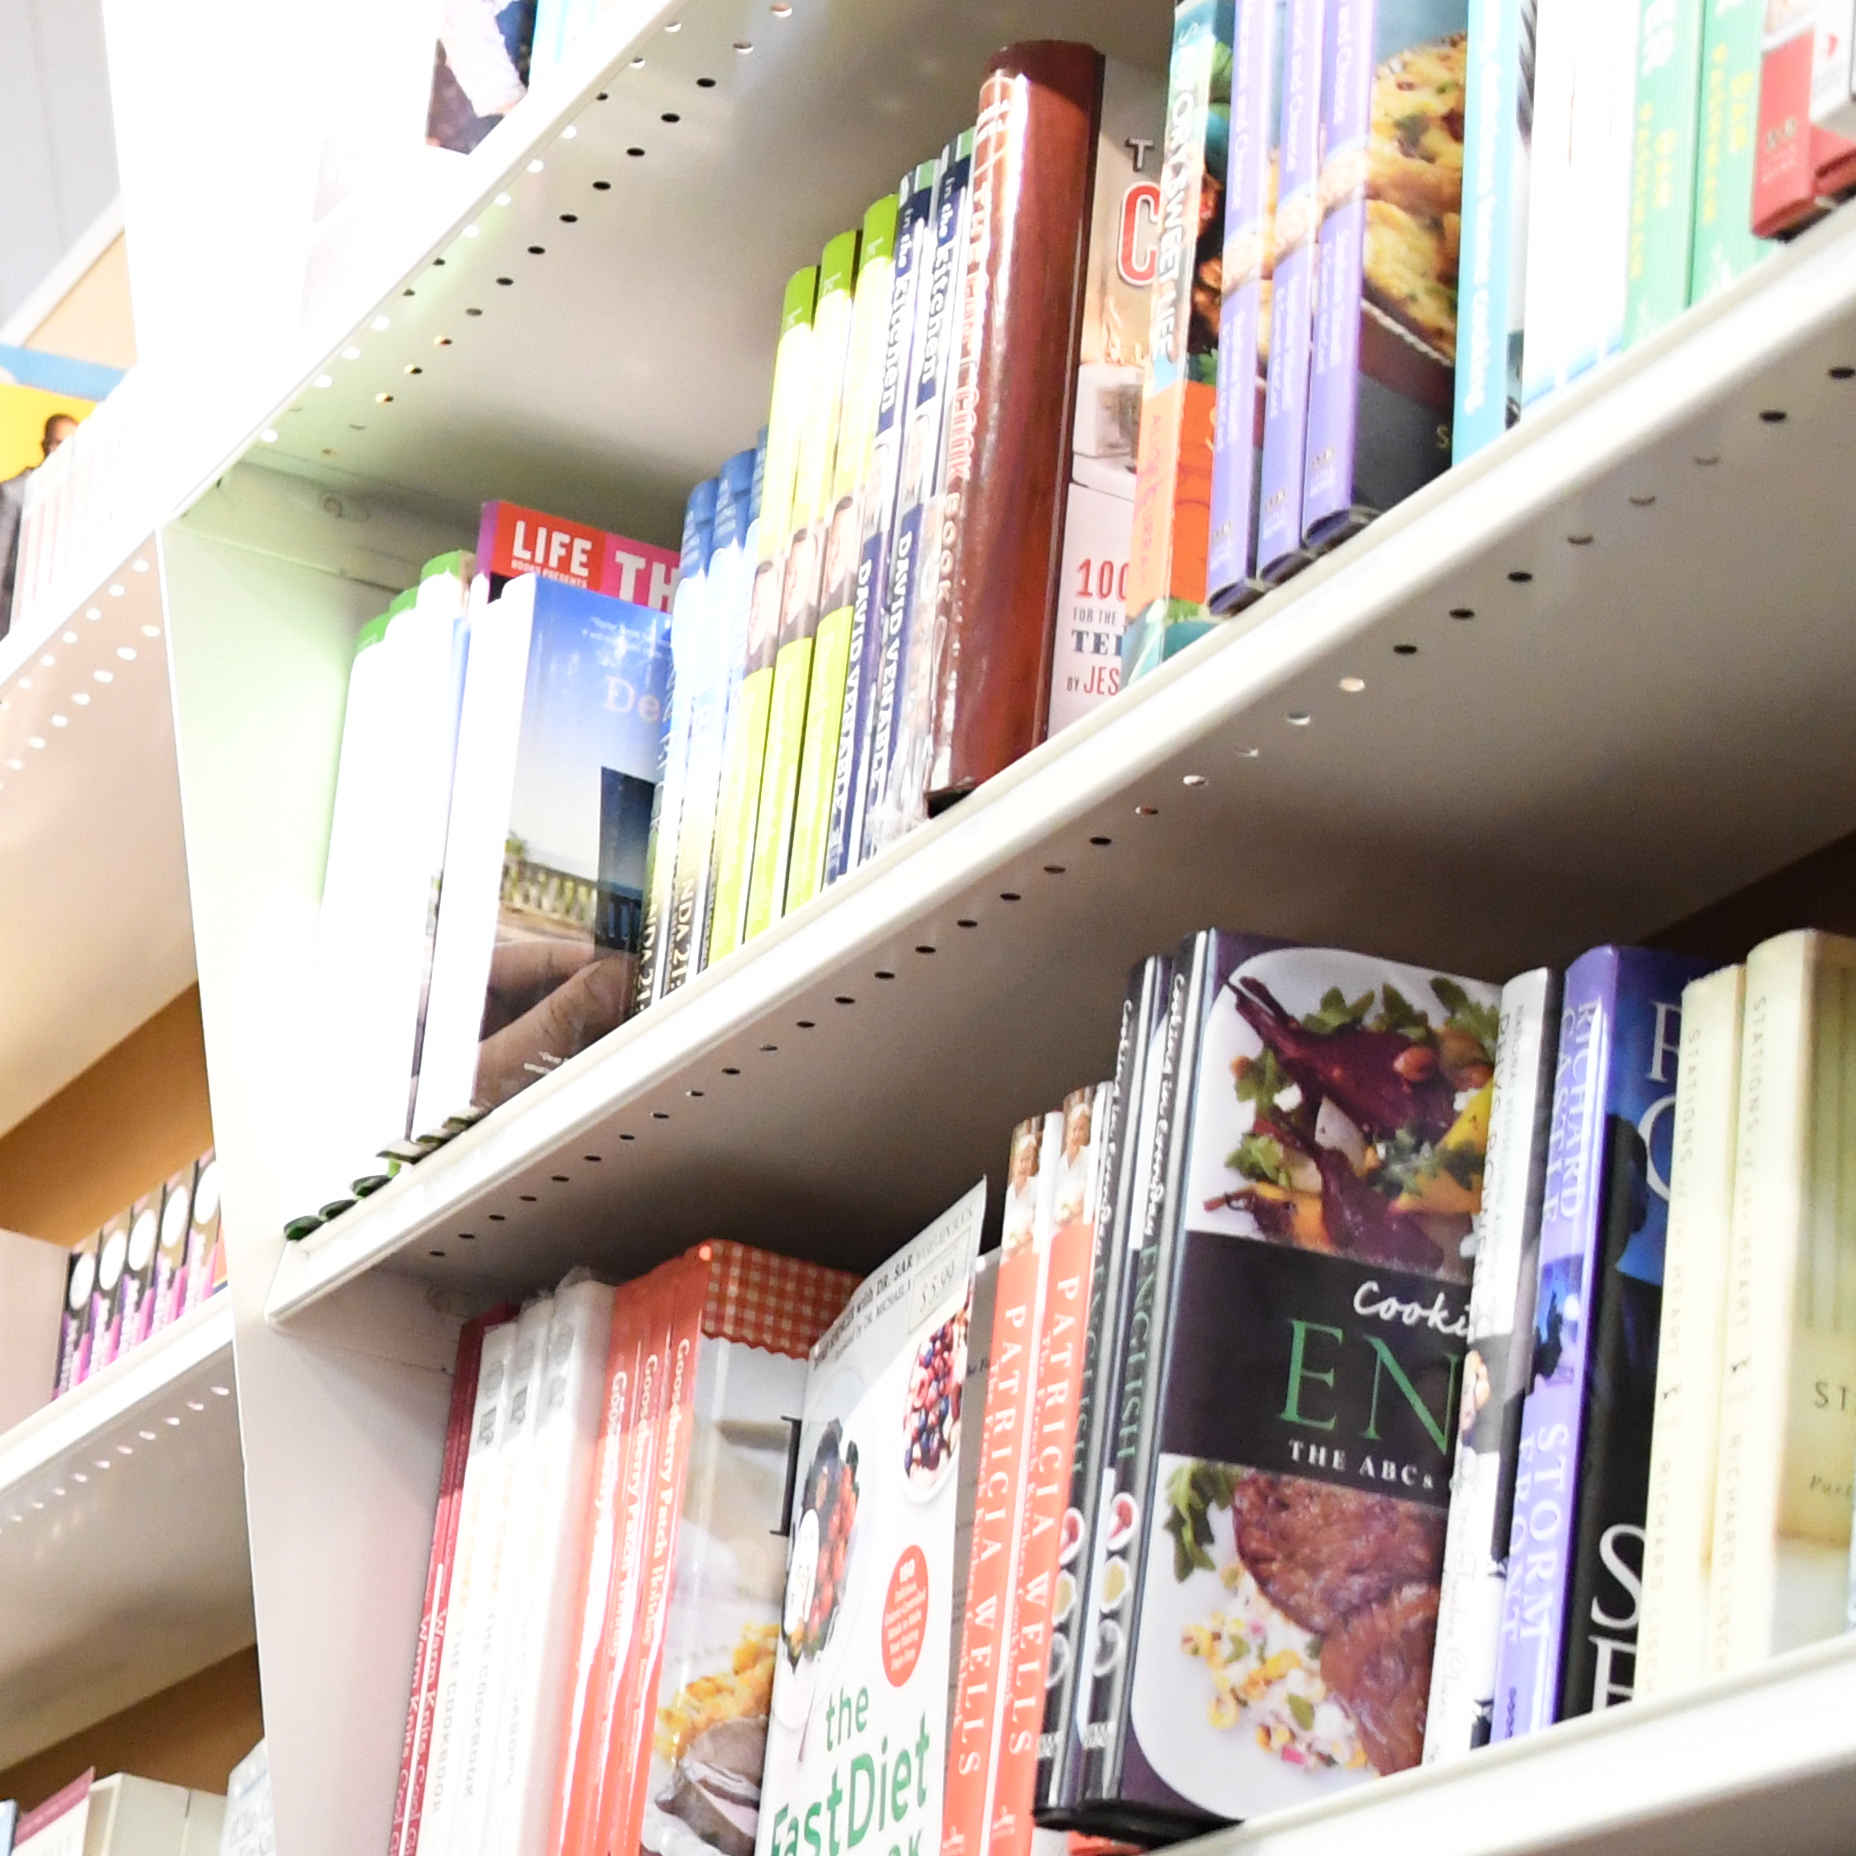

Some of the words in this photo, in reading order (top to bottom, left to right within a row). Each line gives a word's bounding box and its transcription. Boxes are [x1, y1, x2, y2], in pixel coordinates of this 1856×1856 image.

[512, 520, 592, 577] LIFE
[890, 531, 913, 634] DAVID
[850, 558, 872, 663] DAVID
[1073, 607, 1094, 624] FOR
[1098, 609, 1117, 626] THE
[1066, 676, 1080, 693] BY
[980, 1303, 1028, 1564] PATRICIA
[1033, 1274, 1080, 1537] PATRICIA
[1289, 1440, 1348, 1472] THE
[1519, 1419, 1570, 1639] STORM
[958, 1593, 997, 1776] WELLS
[1008, 1569, 1050, 1755] WELLS
[826, 1686, 869, 1751] the
